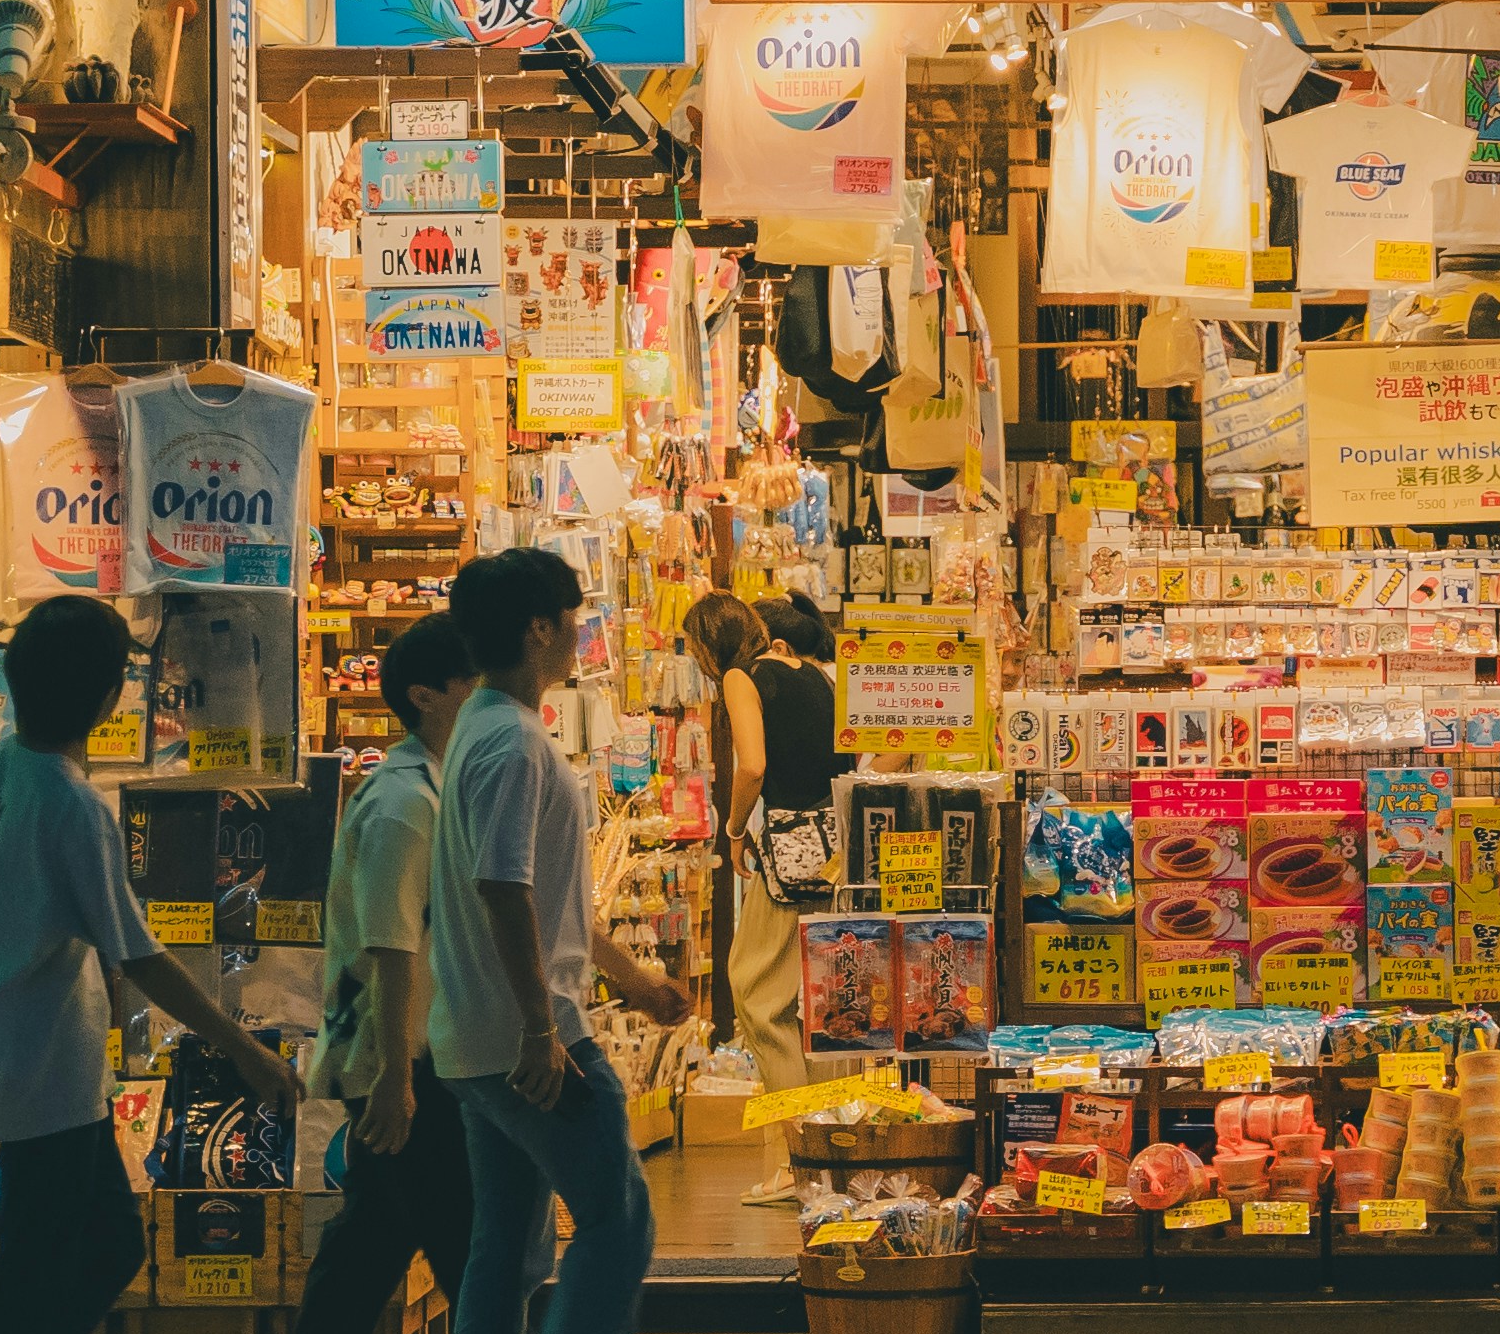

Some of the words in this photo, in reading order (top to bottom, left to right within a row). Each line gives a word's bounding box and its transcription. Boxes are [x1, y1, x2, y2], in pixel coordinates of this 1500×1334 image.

[756, 28, 862, 70] Orion
[775, 80, 801, 97] THE
[802, 80, 844, 97] DRAFT
[410, 104, 446, 113] OKINAWA
[398, 112, 457, 124] ナンバープレート
[401, 150, 465, 164] JAPAN
[1113, 144, 1193, 178] Orion
[1339, 165, 1371, 183] BLUE
[1372, 166, 1402, 182] SEAL
[381, 173, 481, 201] OKINAWA
[849, 183, 879, 194] 2750
[1126, 183, 1146, 197] THE
[1146, 183, 1178, 198] DRAFT
[1324, 210, 1367, 219] OKINAWAN
[1369, 210, 1381, 219] ICE
[1383, 211, 1409, 220] CREAM
[401, 225, 463, 238] JAPAN
[1380, 242, 1429, 256] ブルーシール
[382, 248, 482, 276] OKINAWA
[1202, 275, 1232, 287] 2640
[1391, 269, 1419, 279] 2800
[404, 298, 466, 312] JAPAN
[385, 320, 486, 350] OKINAWA
[522, 363, 547, 373] post
[570, 362, 618, 372] postcard
[534, 377, 605, 388] 沖縄ポストカード
[539, 392, 596, 402] OKINWAN
[530, 407, 560, 417] POST
[562, 406, 594, 417] CARD
[522, 420, 547, 430] post
[570, 419, 618, 429] postcard
[1339, 444, 1428, 466] Popular
[151, 475, 273, 527] Orion
[1342, 488, 1367, 503] Tax
[1369, 487, 1397, 502] free
[1399, 486, 1420, 501] for
[1416, 496, 1446, 511] 5500
[1453, 496, 1475, 511] yen
[57, 535, 85, 555] THE
[171, 531, 201, 552] THE
[1344, 573, 1370, 605] SPAM
[1375, 569, 1404, 604] SPAM
[847, 610, 895, 622] Tax-free
[898, 613, 917, 623] over
[948, 615, 969, 626] yen
[863, 664, 909, 676] 免税商店
[912, 664, 960, 676] 欢迎光临
[860, 681, 895, 693] 购物满
[899, 681, 934, 694] 5,500
[938, 681, 961, 693] 日元
[876, 697, 933, 709] 以上可免税
[862, 714, 908, 726] 免税商店
[912, 714, 959, 726] 欢迎光临
[1163, 786, 1228, 798] 紅いもタルト
[1279, 785, 1344, 797] 紅いもタルト
[1375, 792, 1439, 814] パイの実
[883, 834, 939, 845] 北海道名産
[889, 845, 933, 855] 日高昆布
[885, 871, 937, 883] 北の海から
[1376, 909, 1439, 930] パイの実
[1041, 958, 1120, 974] ちんすこう
[1178, 962, 1231, 976] 御菓子御殿
[1296, 957, 1349, 969] 御菓子御殿
[1059, 978, 1102, 999] 675
[1148, 984, 1230, 1001] 紅いもタルト
[1265, 980, 1332, 993] 紅いもタルト
[1473, 987, 1499, 1001] 820
[1073, 1103, 1124, 1121] 出前一丁
[1049, 1174, 1095, 1189] 出前一丁
[1059, 1195, 1085, 1208] 734
